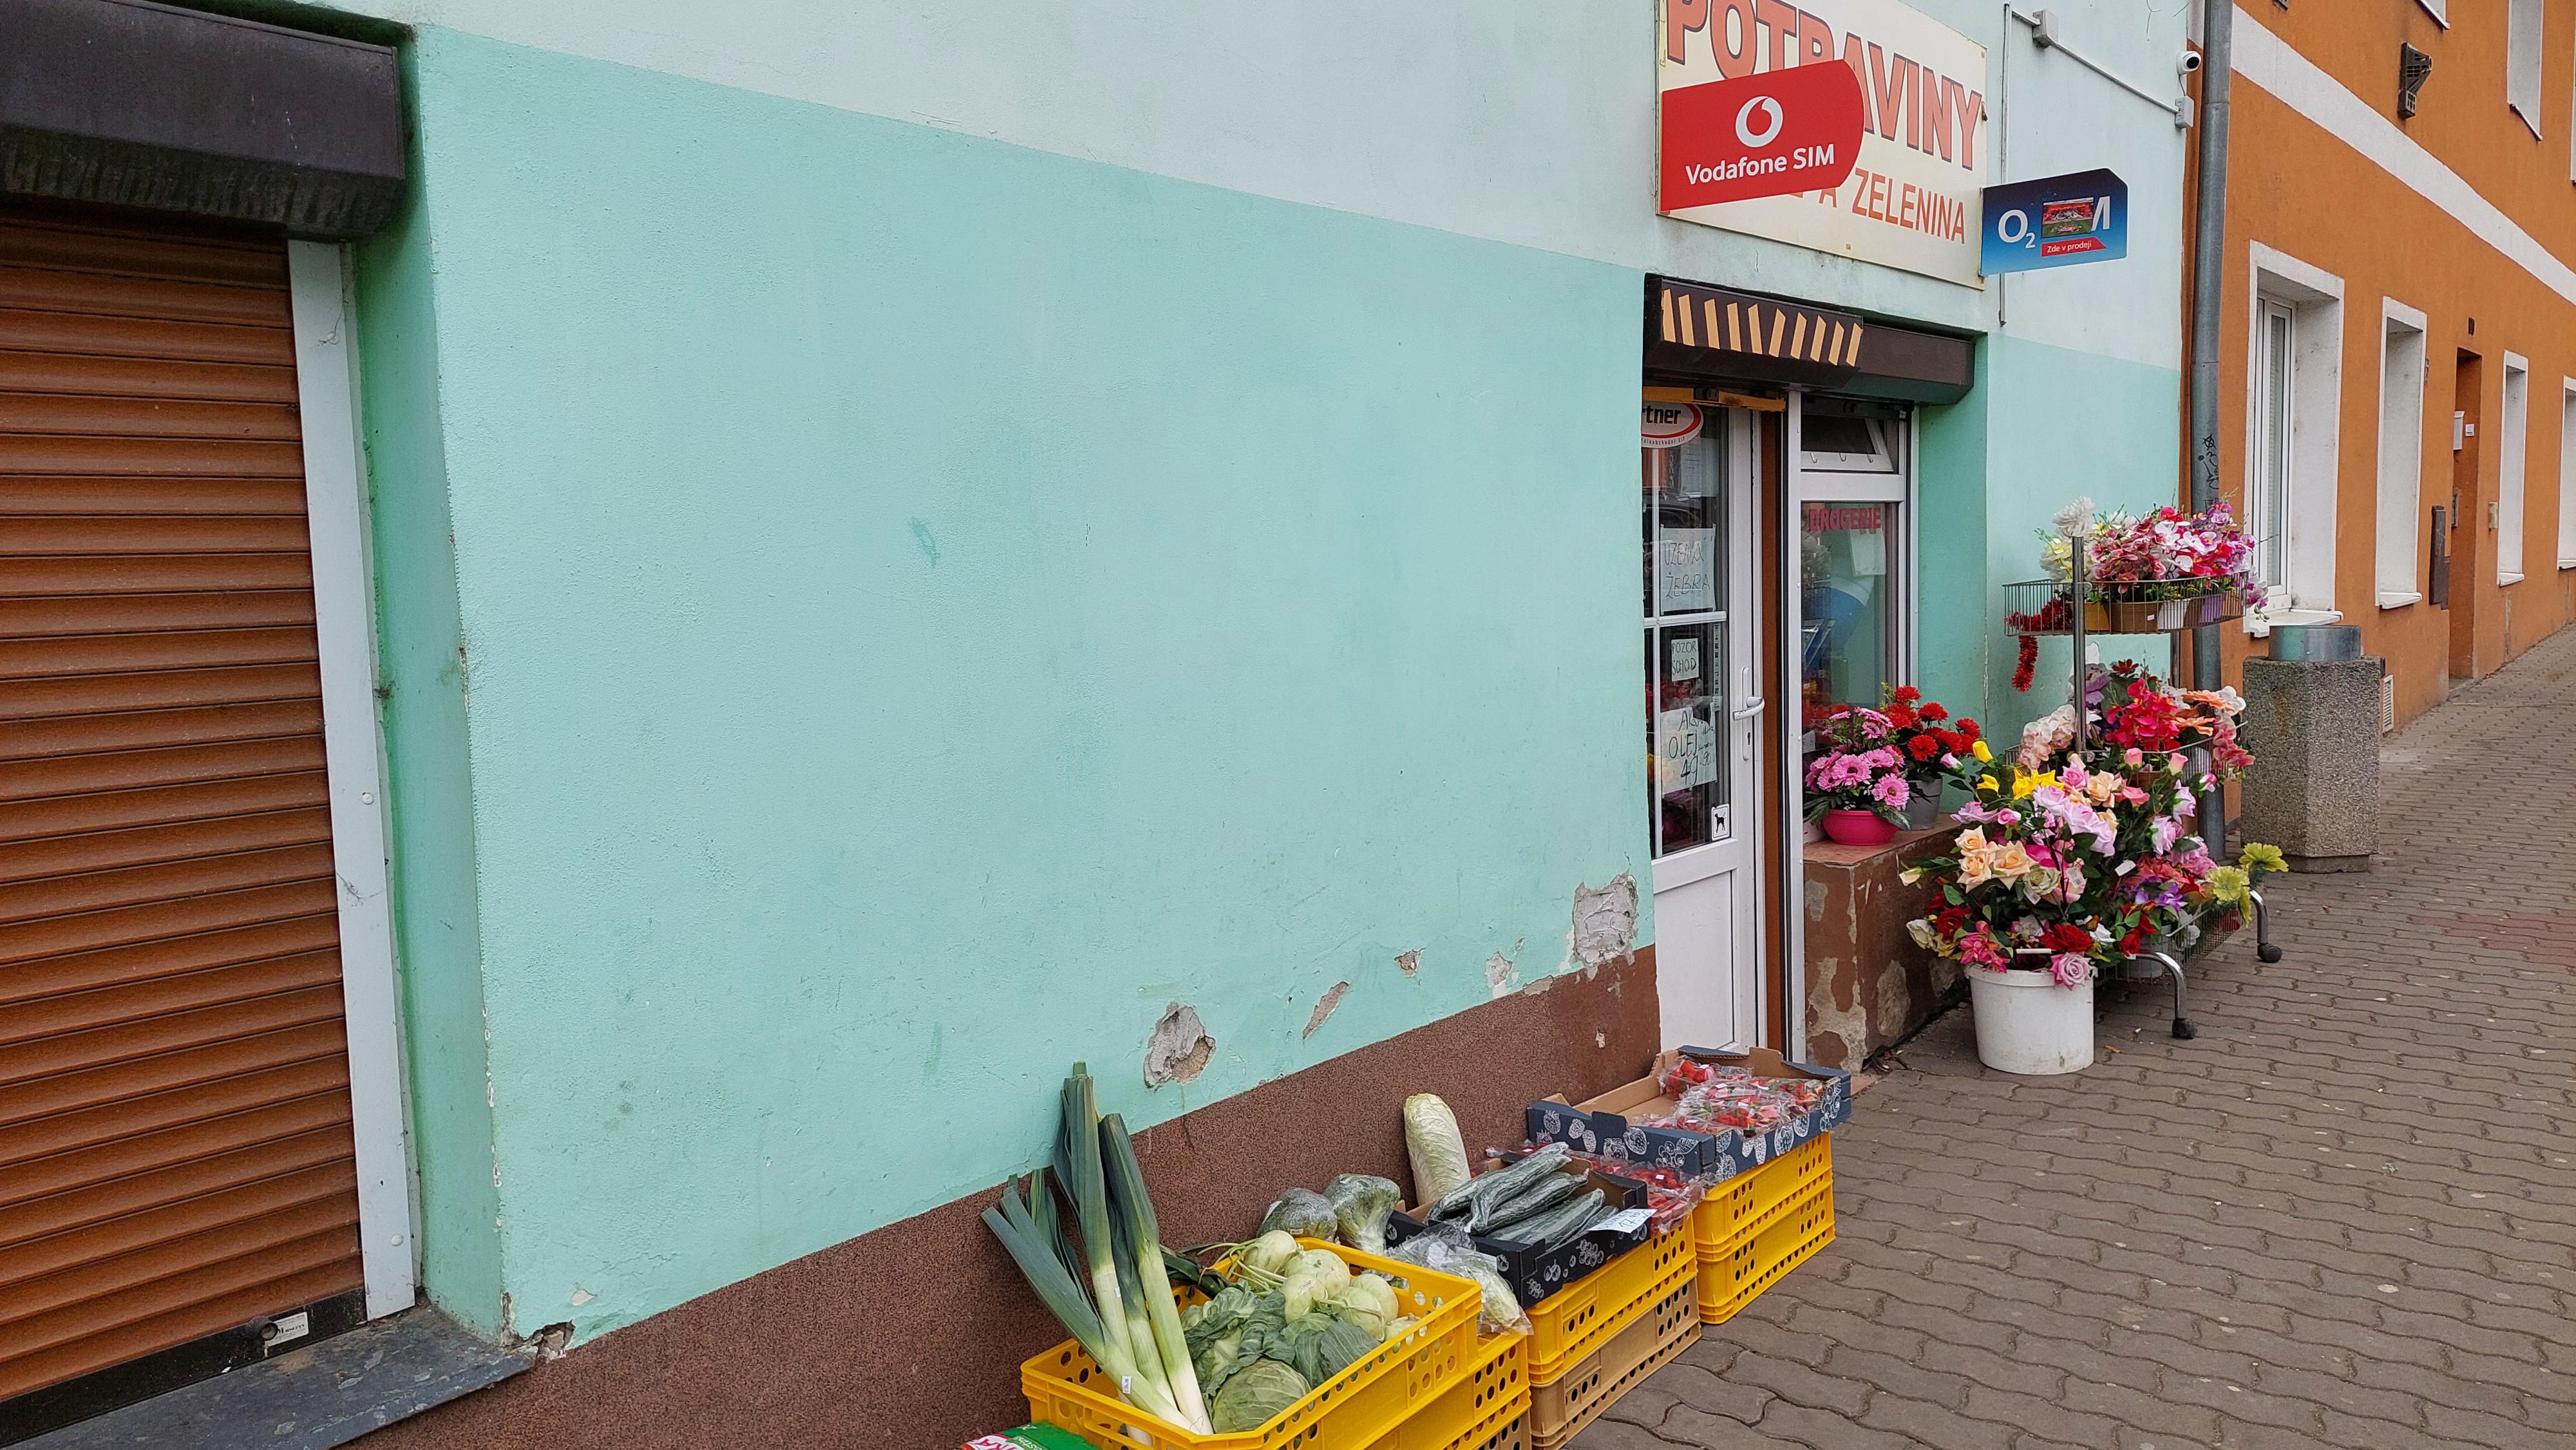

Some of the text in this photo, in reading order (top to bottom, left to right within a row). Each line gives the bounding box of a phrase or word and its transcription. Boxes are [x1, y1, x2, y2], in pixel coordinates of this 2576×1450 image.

[1667, 0, 1982, 171] POTRAVINY
[1685, 144, 1835, 185] Vodafone SIM
[1852, 167, 1965, 244] ZELENINA
[2047, 244, 2061, 253] Zde
[2067, 240, 2092, 252] prodeji
[1808, 507, 1881, 532] DROGERIE
[1672, 657, 1697, 675] SCHOD
[1669, 730, 1698, 758] OLEJ
